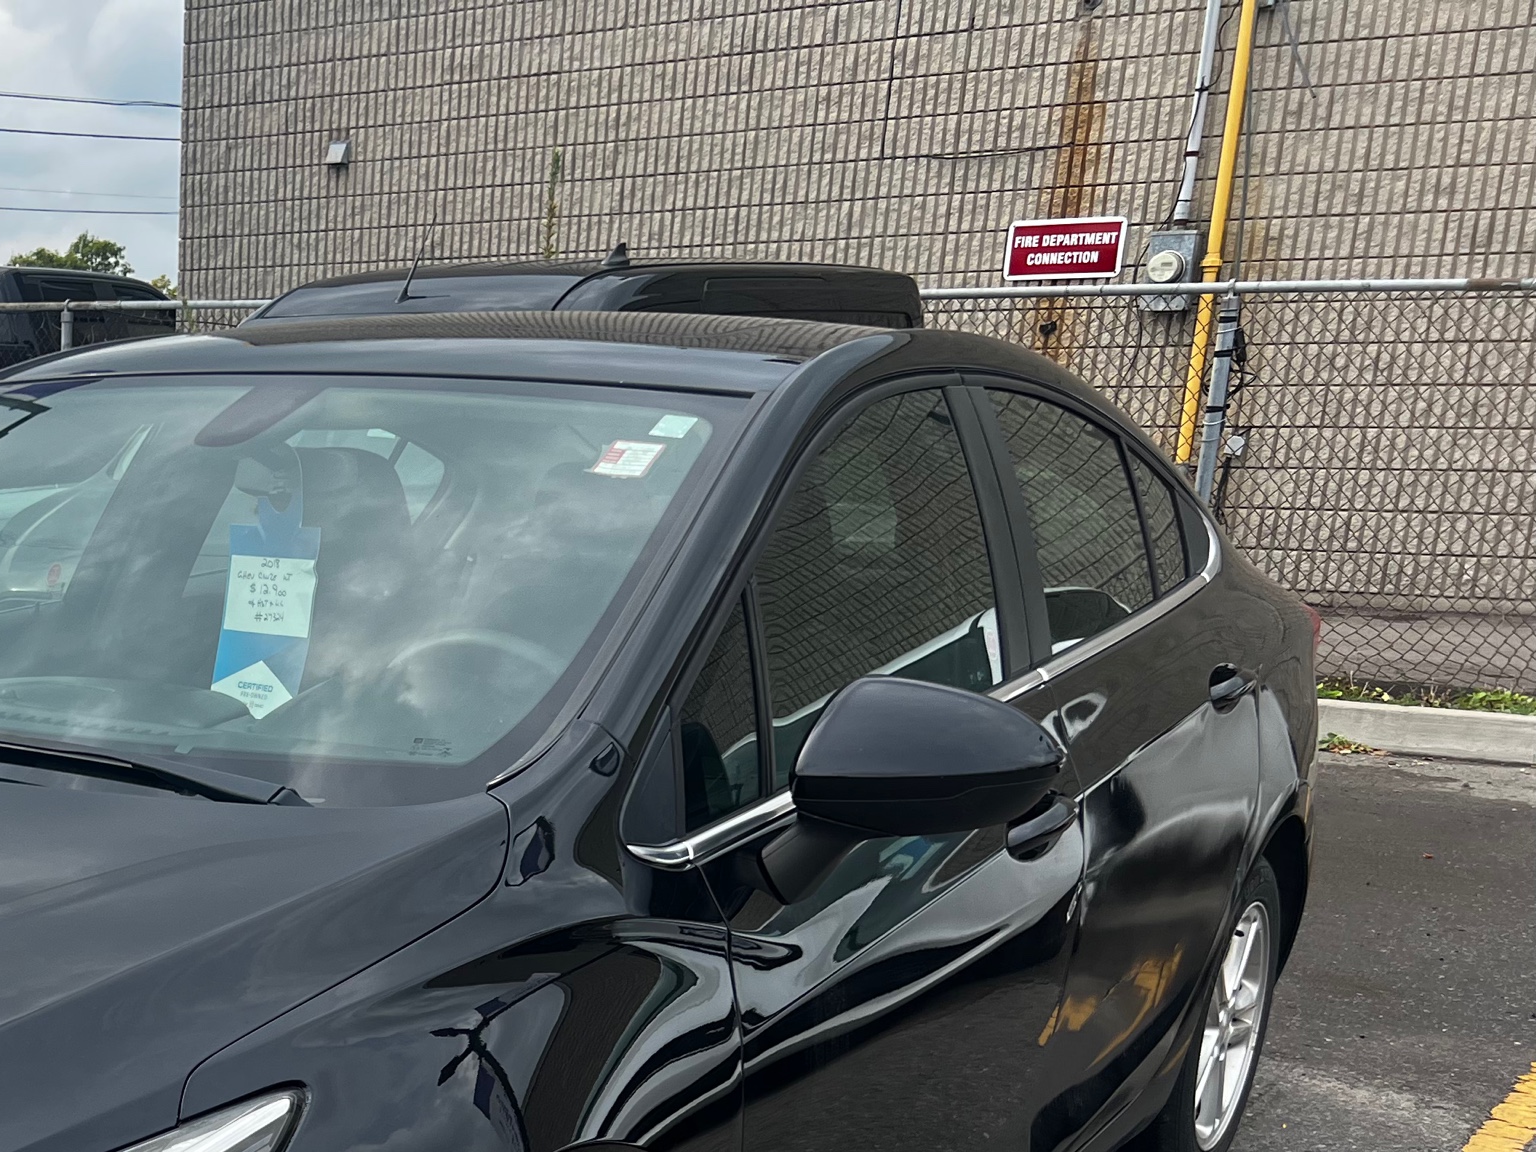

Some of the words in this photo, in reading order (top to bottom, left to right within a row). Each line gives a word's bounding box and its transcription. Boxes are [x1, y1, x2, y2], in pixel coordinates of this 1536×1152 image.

[1014, 235, 1039, 248] FIRE
[1041, 232, 1119, 247] DEPARTMENT
[1026, 250, 1100, 266] CONNECTION
[260, 558, 281, 569] 2018
[237, 681, 274, 693] CERTIFIED
